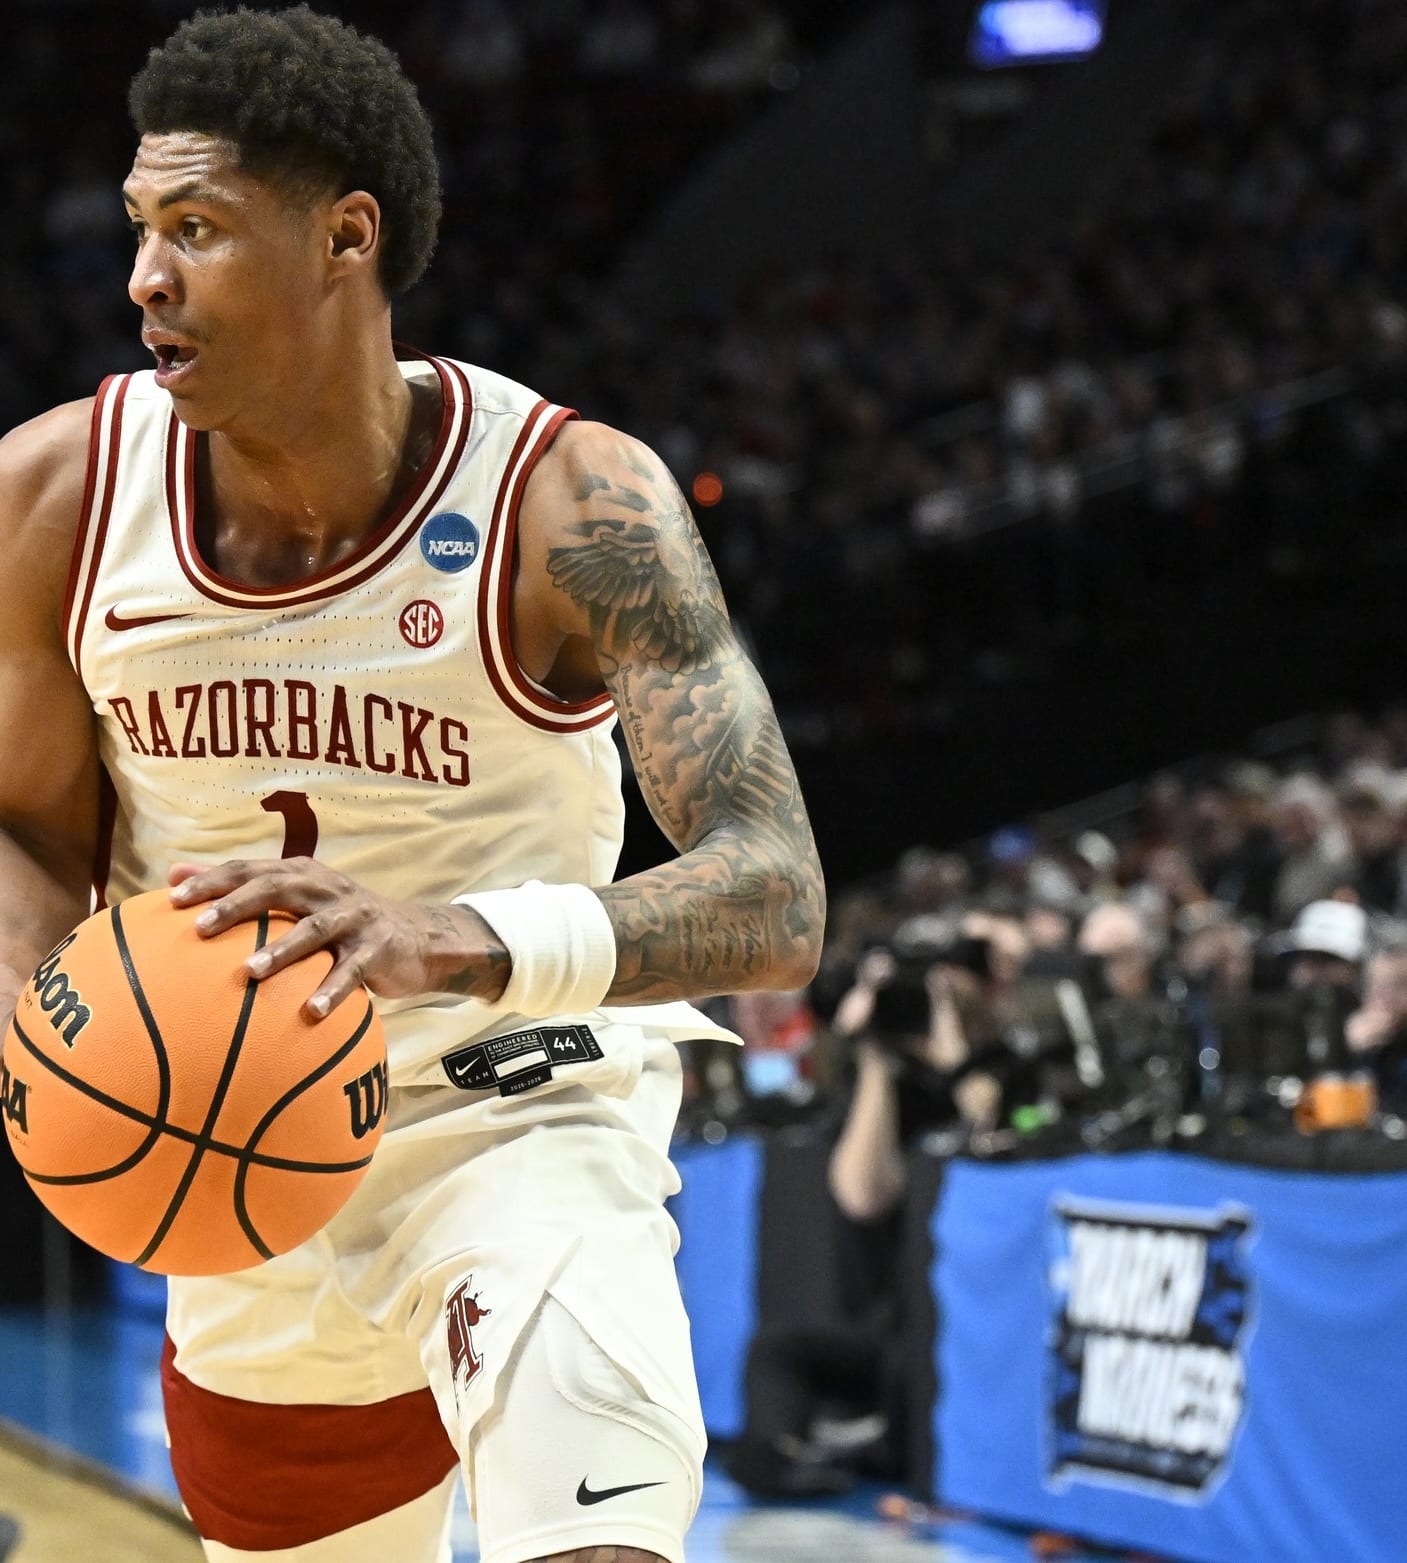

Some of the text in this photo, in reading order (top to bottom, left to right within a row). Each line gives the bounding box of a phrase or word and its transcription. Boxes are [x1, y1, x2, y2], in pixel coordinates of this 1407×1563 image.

[428, 540, 475, 556] NCAA
[404, 604, 439, 643] SEC
[108, 678, 470, 787] RAZORBACKS
[487, 1033, 538, 1051] ENGINEERED
[553, 1036, 577, 1051] 44
[460, 1071, 490, 1085] TEAM
